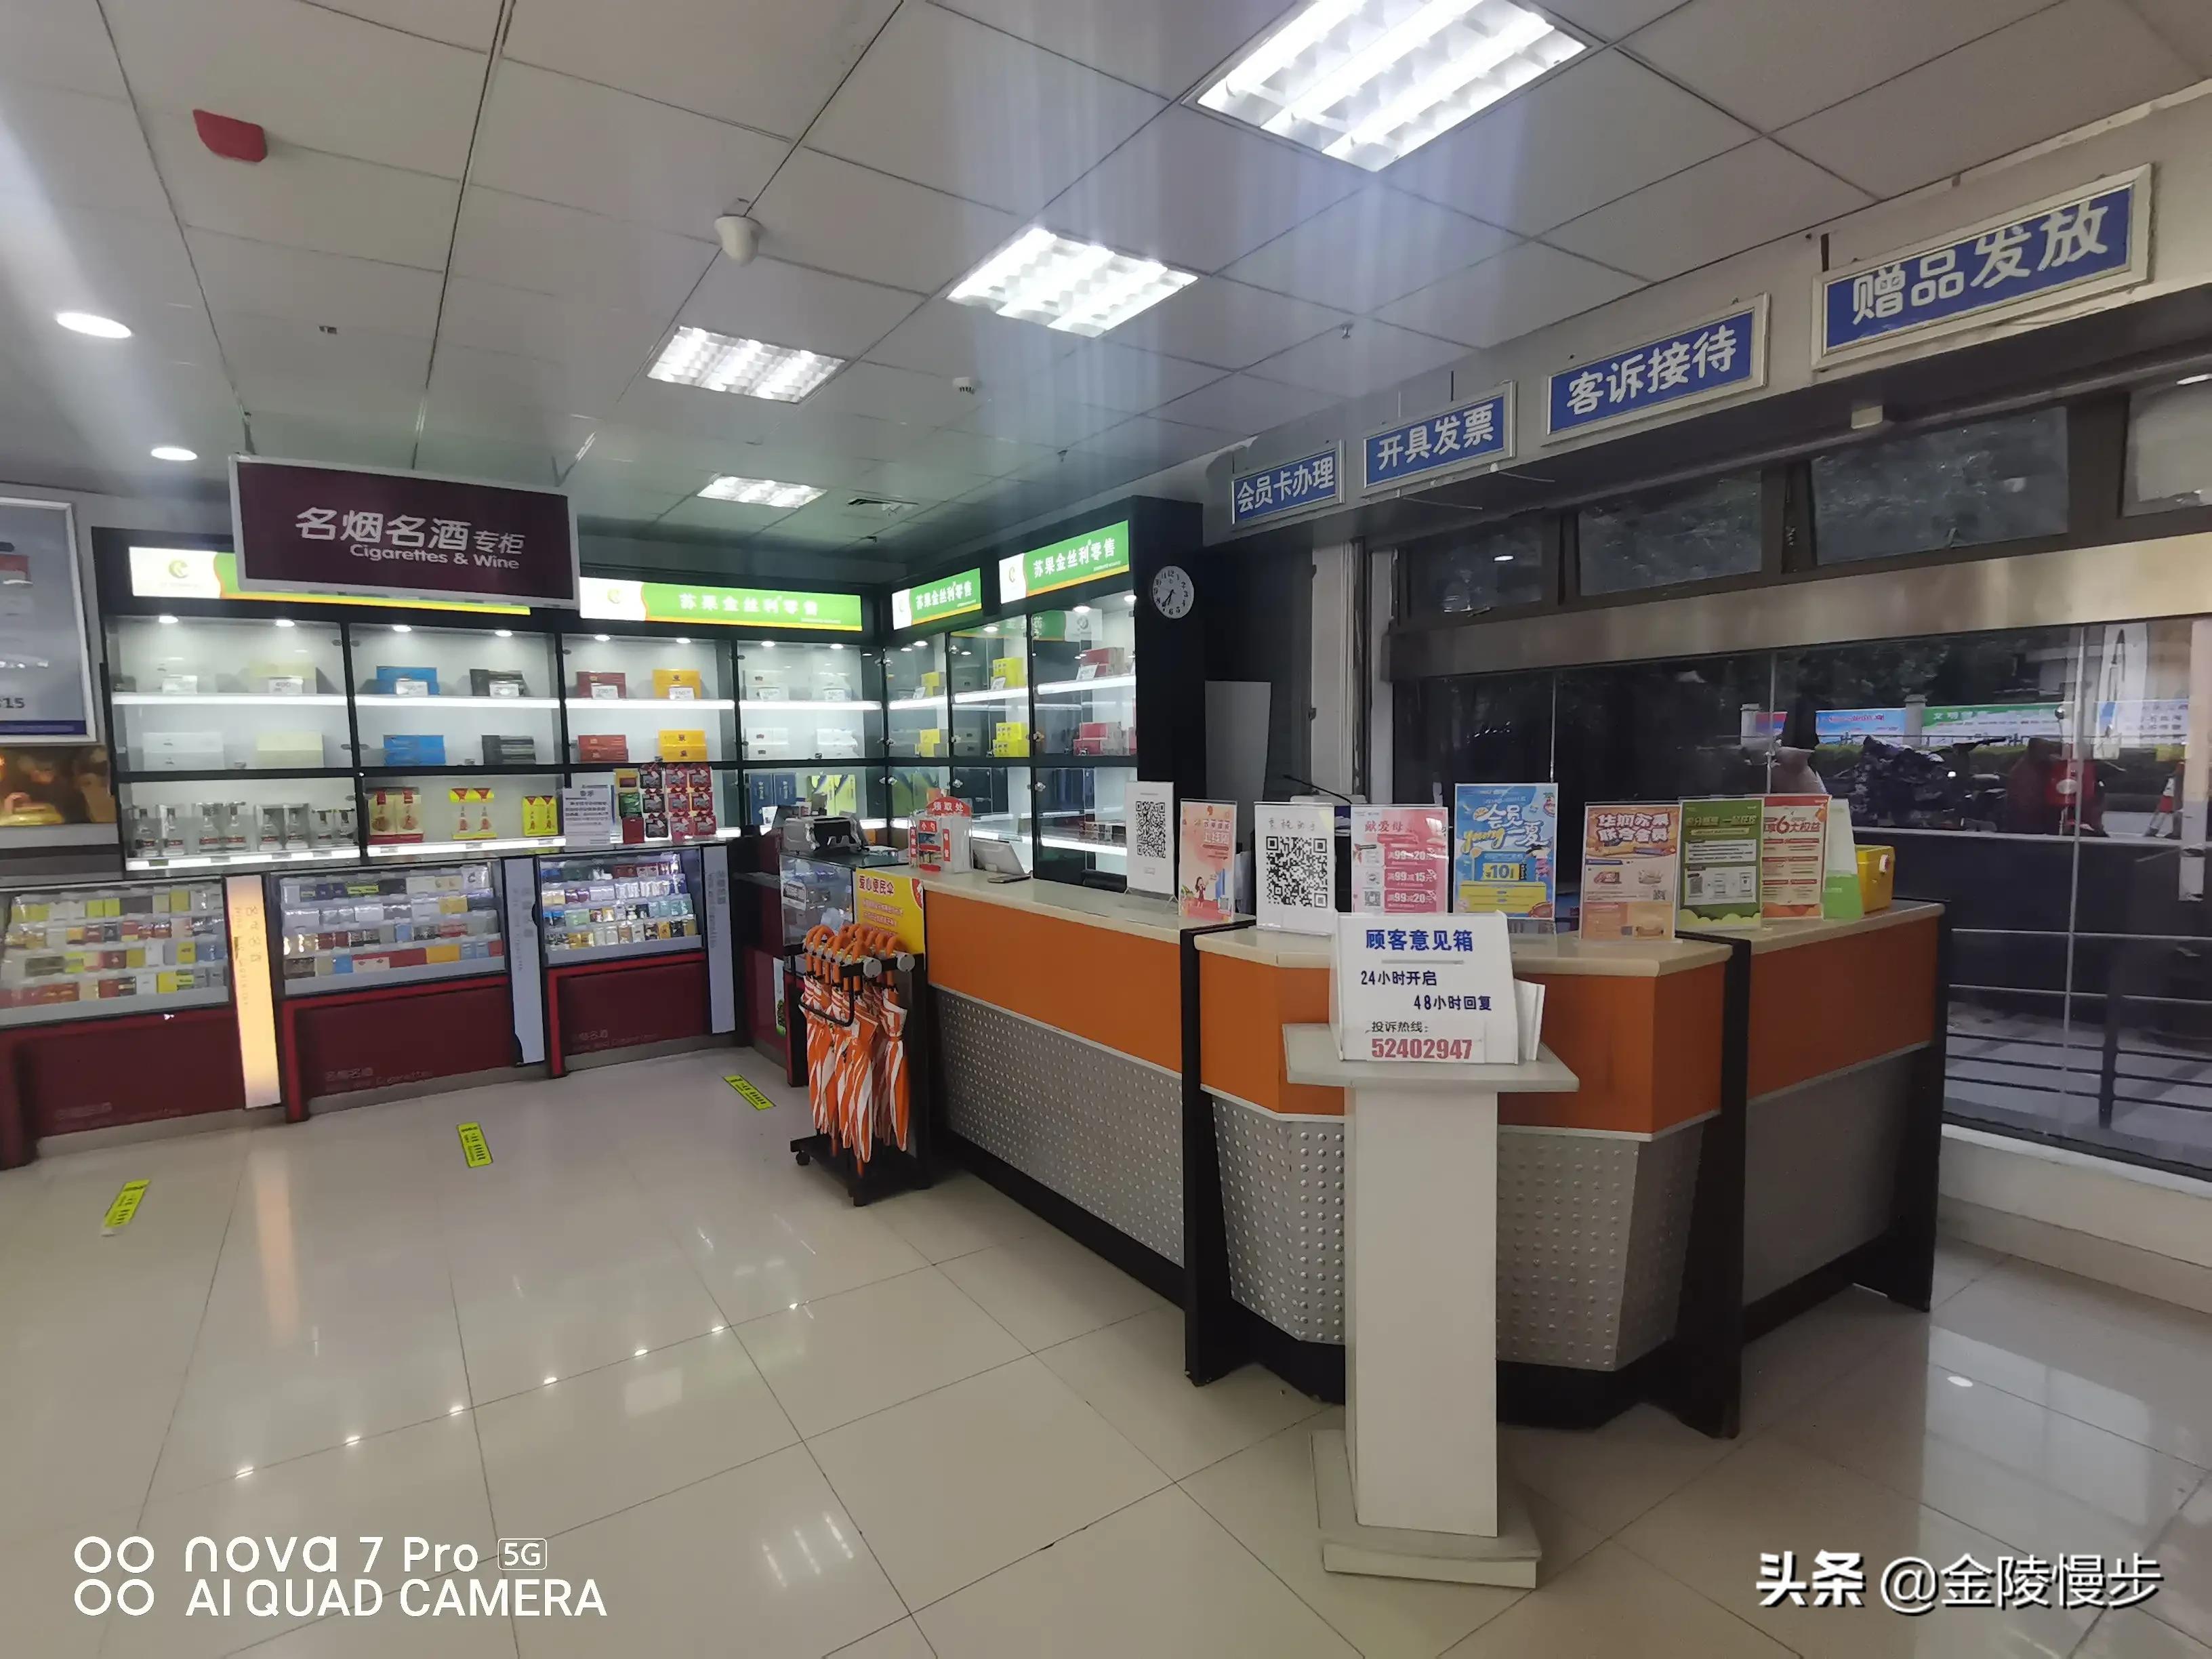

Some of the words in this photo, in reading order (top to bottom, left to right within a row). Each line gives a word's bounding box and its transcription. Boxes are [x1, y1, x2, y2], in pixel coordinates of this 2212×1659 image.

[1853, 200, 2109, 324] 赠品发放
[1568, 325, 1736, 415] 客诉接待
[1377, 403, 1494, 470] 开具发票
[1236, 455, 1334, 512] 会员卡办理
[350, 544, 448, 563] Cigarettes
[453, 552, 469, 565] &
[474, 554, 520, 569] Wine
[1366, 928, 1473, 951] 顾客意见箱
[1361, 970, 1437, 986] 24小时开启
[1414, 995, 1492, 1011] 48小时回复
[1371, 1038, 1473, 1060] 52402947
